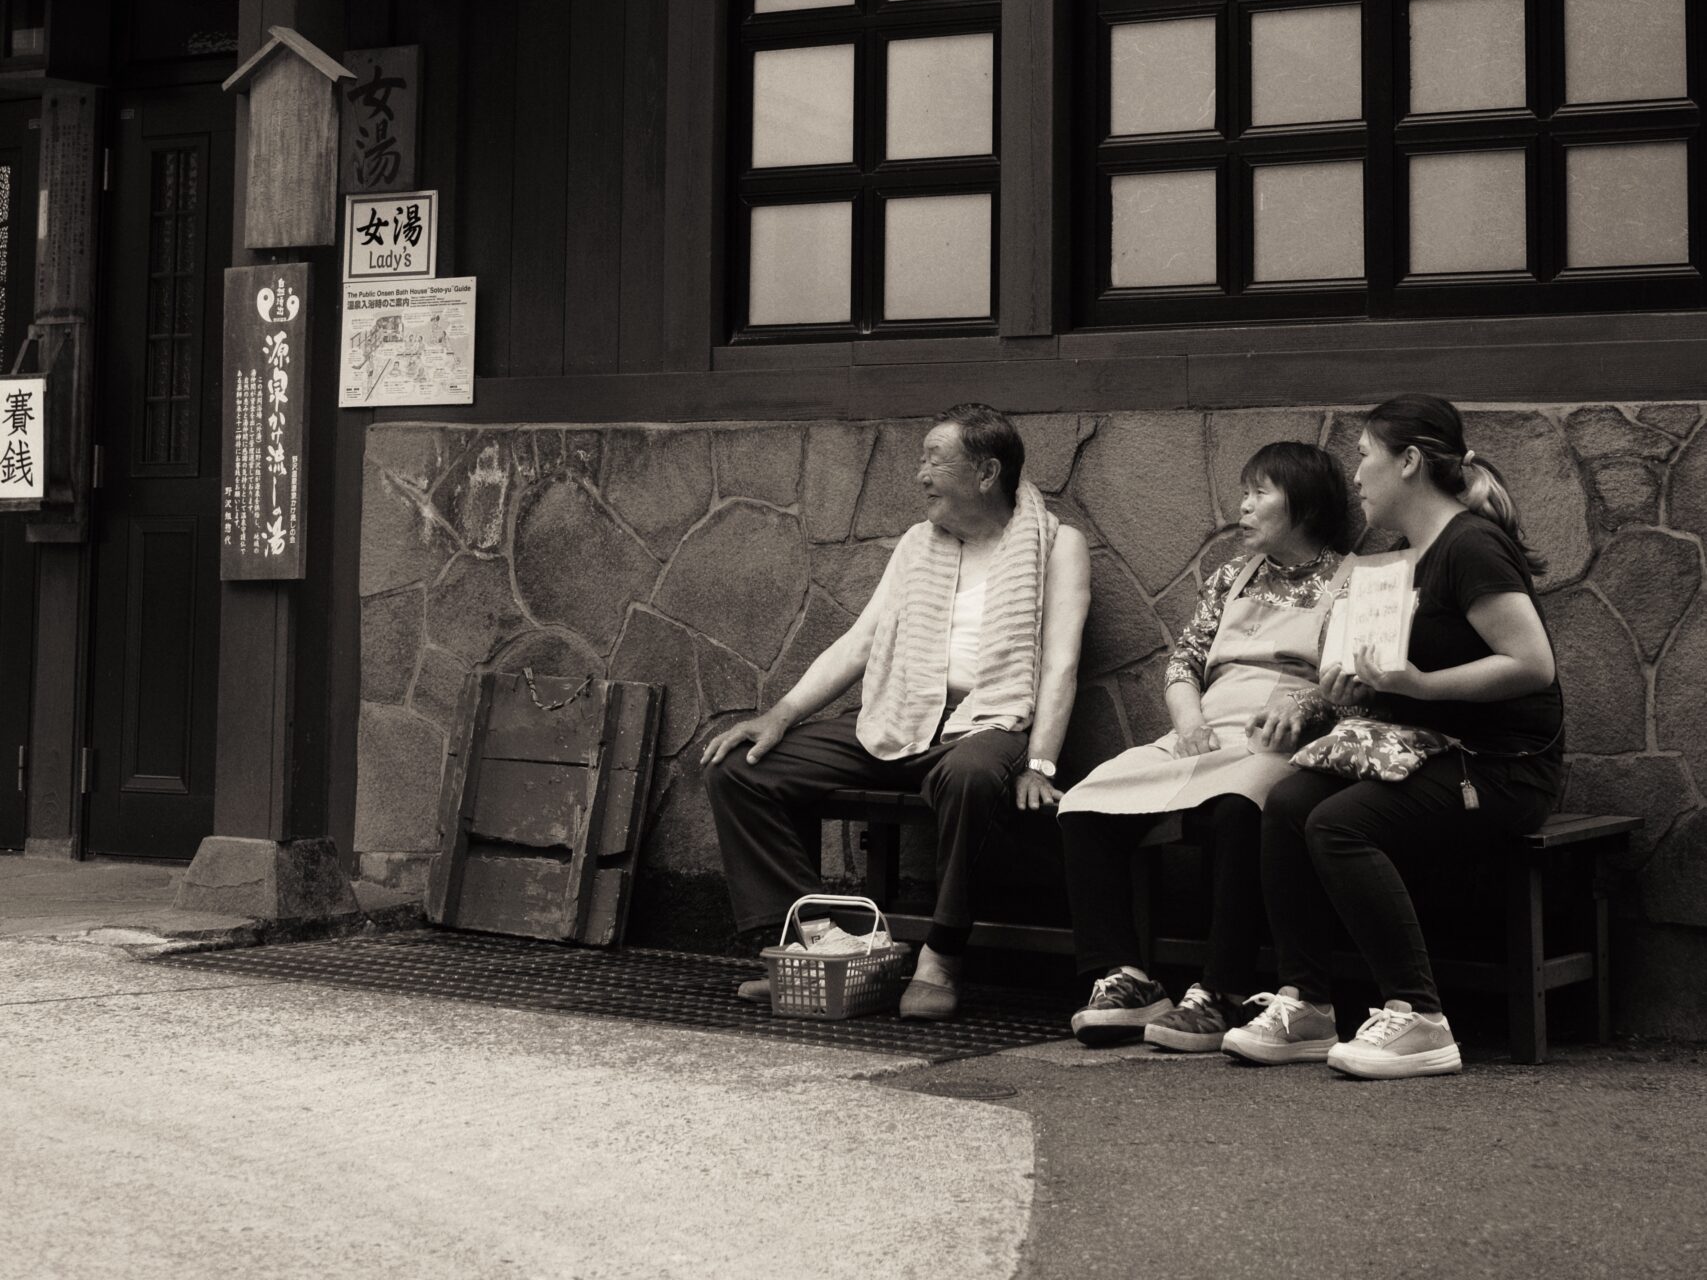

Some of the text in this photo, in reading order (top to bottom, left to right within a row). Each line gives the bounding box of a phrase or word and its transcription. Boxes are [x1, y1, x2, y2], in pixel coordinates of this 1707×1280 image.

[347, 65, 407, 188] 女湯
[356, 203, 423, 247] 女湯
[369, 246, 412, 271] Lady's
[347, 297, 410, 310] 温泉入浴時のご案内
[359, 290, 376, 298] Public
[396, 288, 409, 296] Bath
[0, 388, 35, 487] 賽銭
[261, 330, 290, 558] 源泉かけ流しの湯
